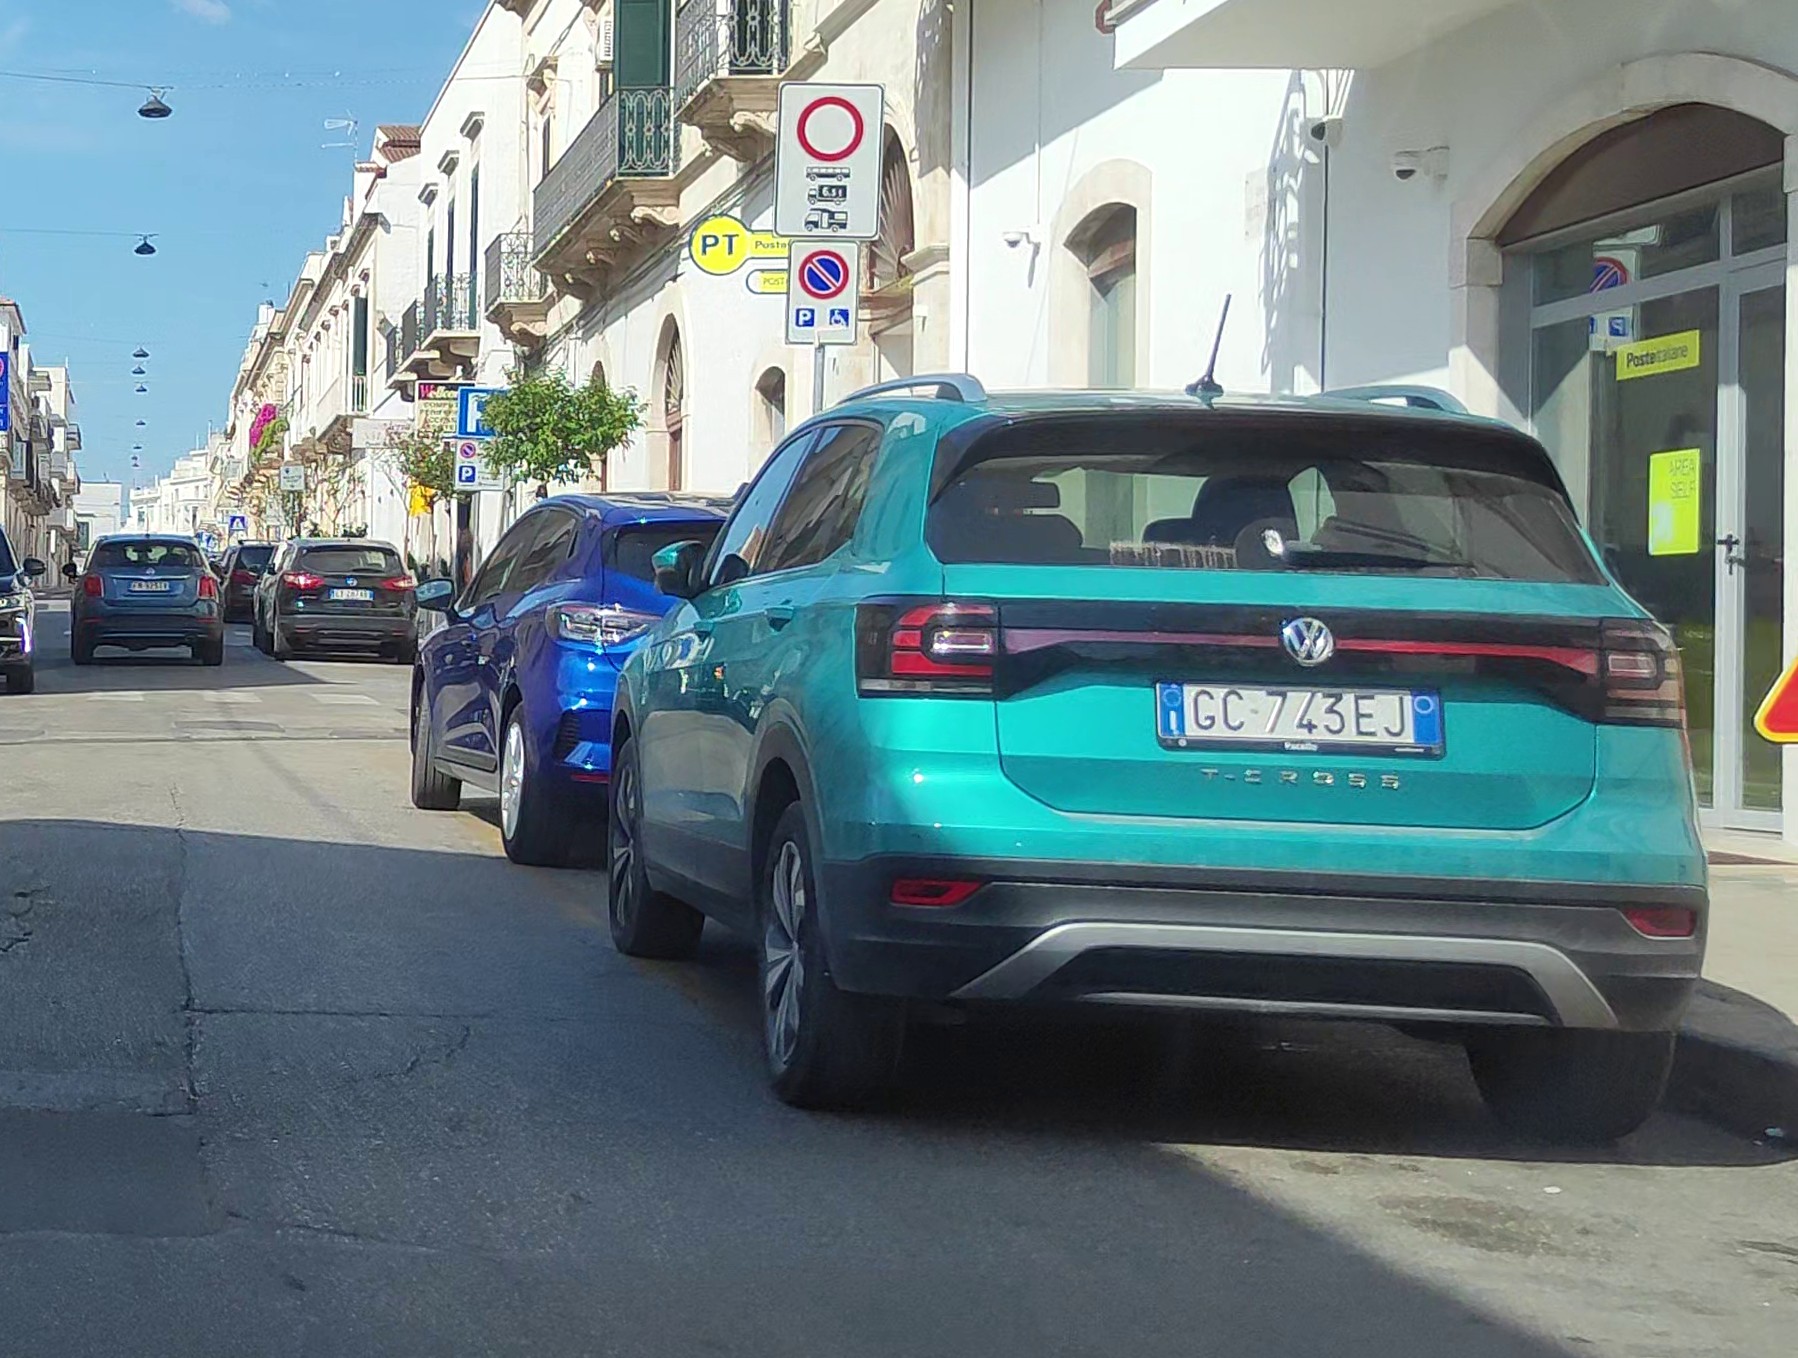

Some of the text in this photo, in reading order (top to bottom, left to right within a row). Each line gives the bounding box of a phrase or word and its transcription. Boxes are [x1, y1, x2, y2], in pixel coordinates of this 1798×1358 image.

[701, 234, 739, 256] PT
[755, 241, 788, 249] Posta
[763, 277, 788, 285] POST
[799, 310, 811, 325] P
[461, 467, 473, 481] P
[1192, 689, 1406, 738] GC 743EJ
[1200, 768, 1400, 790] T-CROSS
